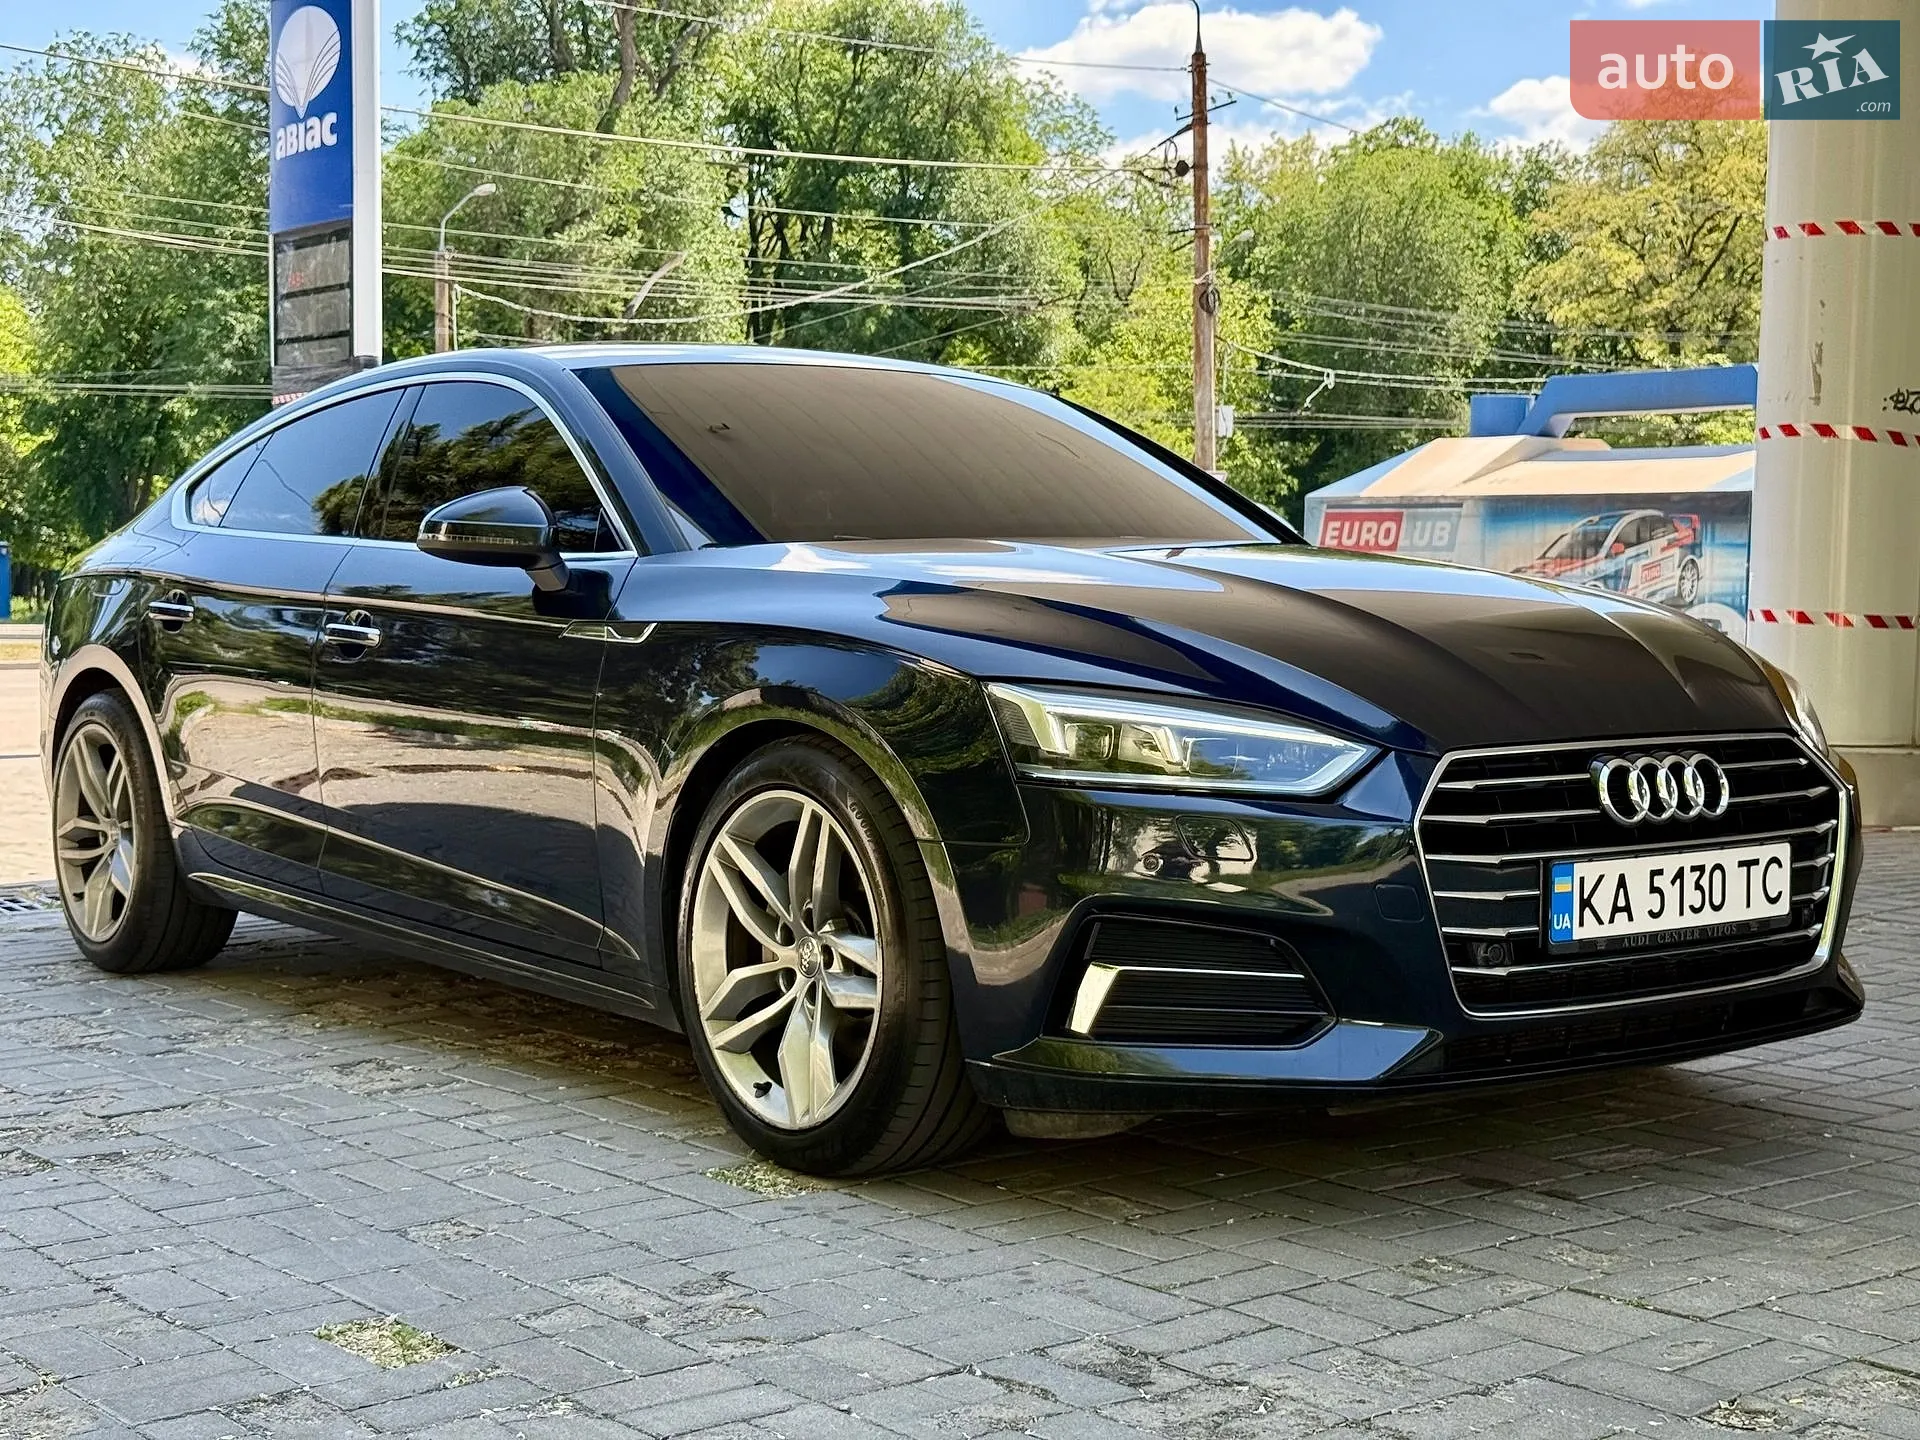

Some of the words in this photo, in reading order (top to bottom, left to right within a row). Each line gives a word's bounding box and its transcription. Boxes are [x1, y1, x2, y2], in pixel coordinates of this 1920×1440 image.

[1578, 873, 1634, 927] KA
[1647, 863, 1726, 919] 5130
[1737, 856, 1783, 909] TC
[1553, 913, 1571, 930] UA
[1622, 933, 1650, 948] AUDI
[1657, 928, 1700, 944] CENTER
